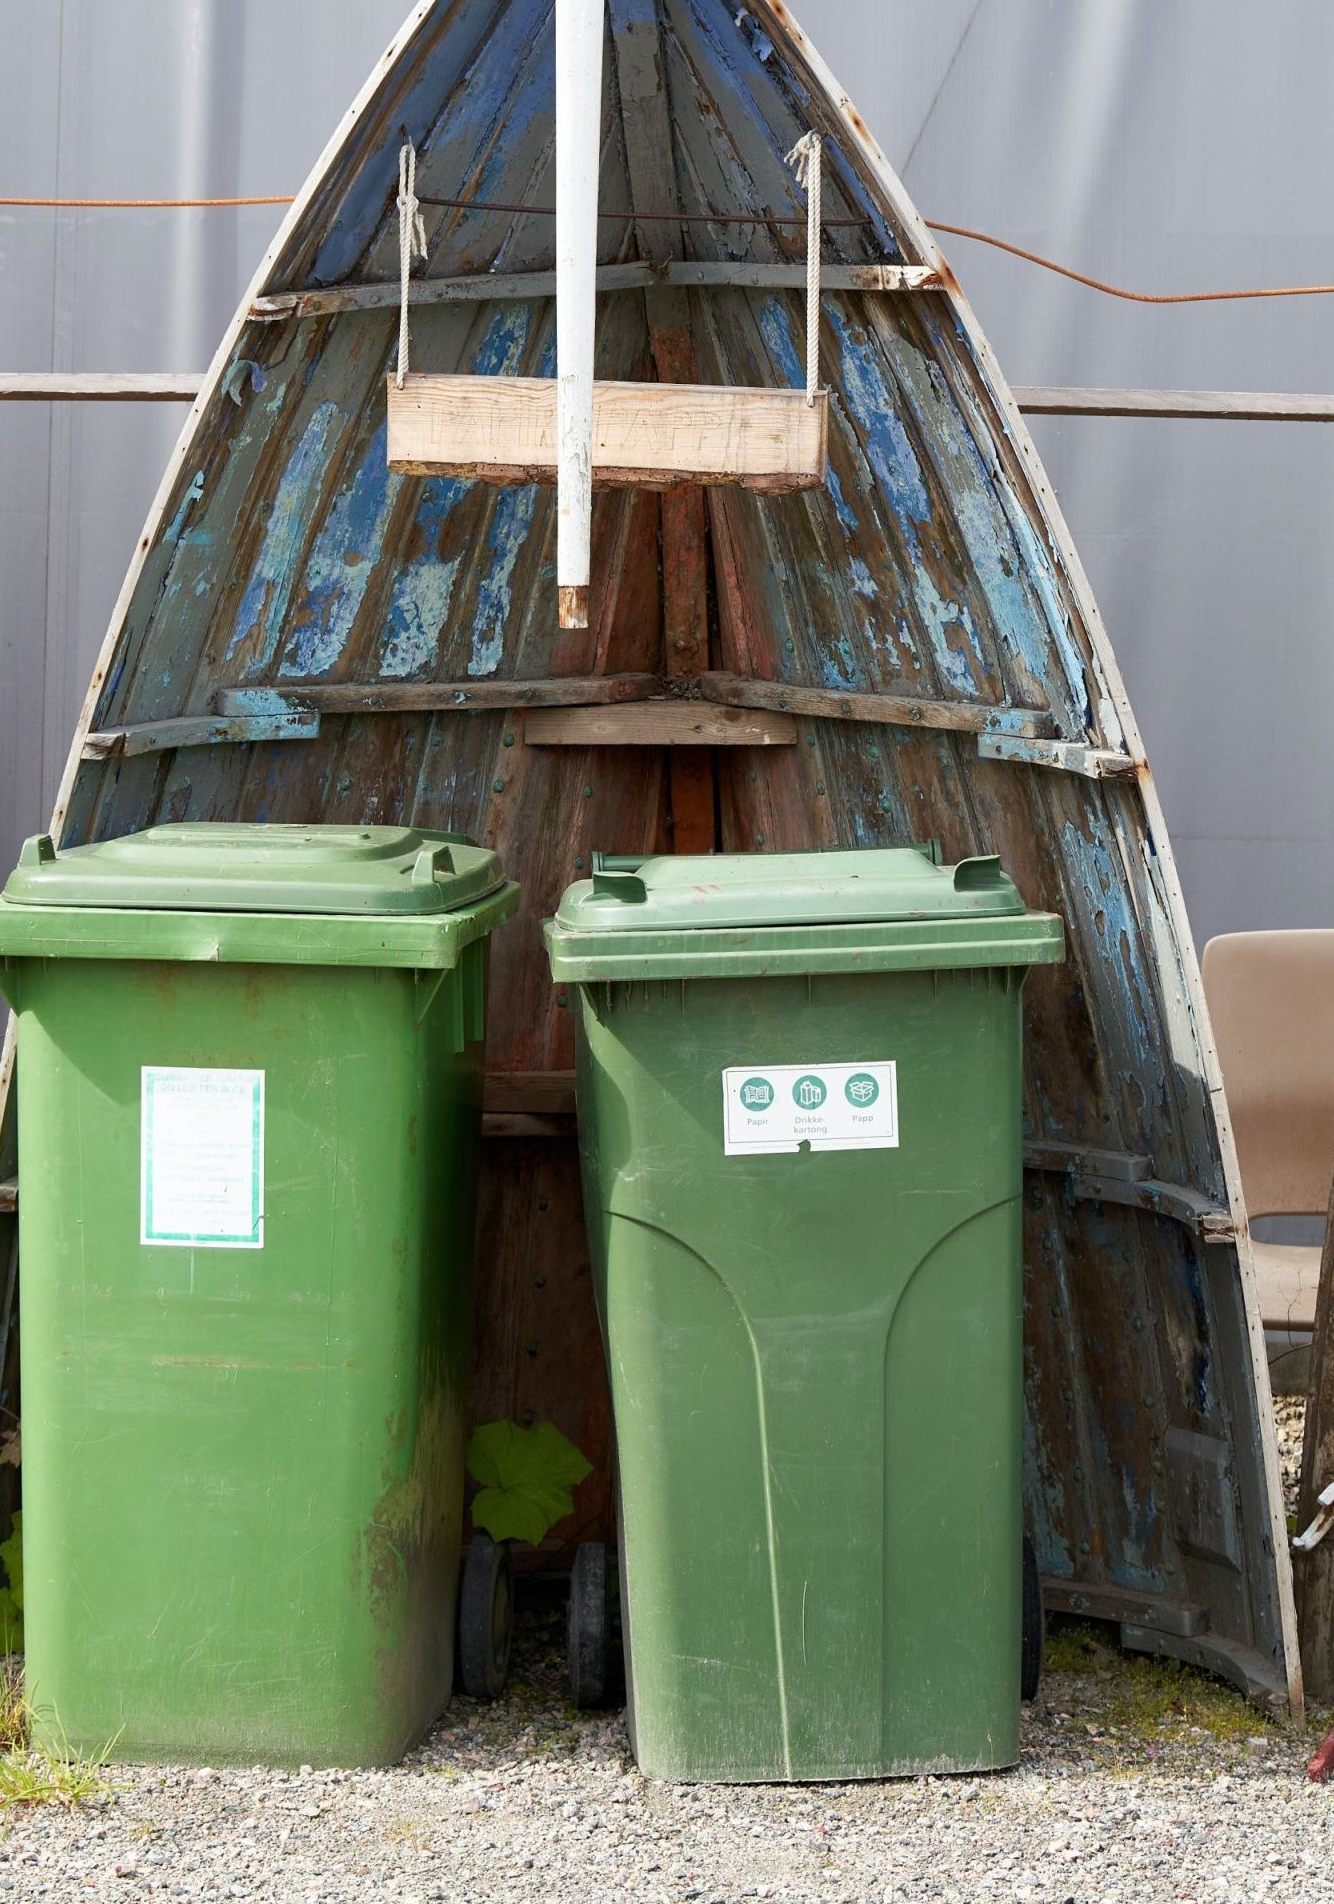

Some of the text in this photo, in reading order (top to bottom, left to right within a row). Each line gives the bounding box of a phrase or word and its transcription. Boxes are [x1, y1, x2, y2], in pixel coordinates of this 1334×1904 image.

[747, 1118, 768, 1127] Papir
[795, 1116, 826, 1124] Drikke-
[852, 1114, 874, 1124] Papp
[793, 1125, 827, 1134] kartong
